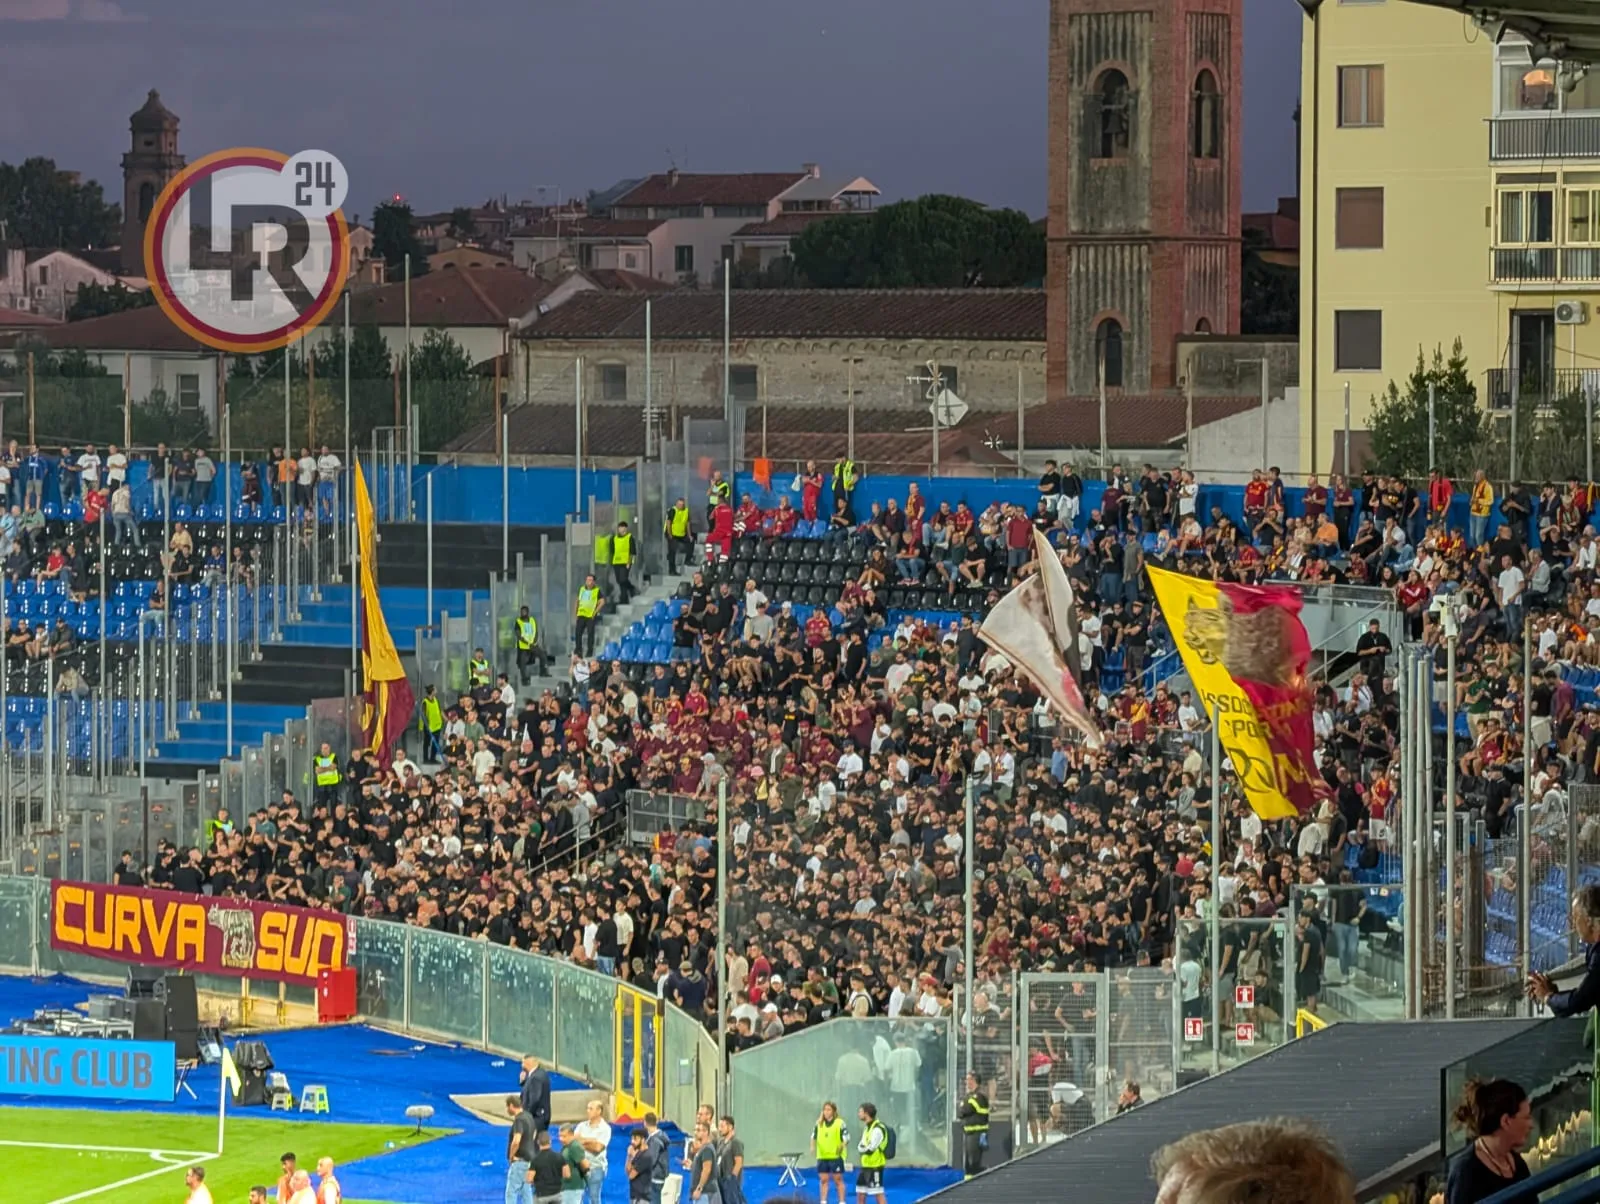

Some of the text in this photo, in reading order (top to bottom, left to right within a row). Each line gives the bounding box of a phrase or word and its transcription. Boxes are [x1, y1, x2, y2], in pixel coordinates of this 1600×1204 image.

[55, 885, 206, 963] CURVA
[257, 911, 344, 978] SUD
[0, 1046, 153, 1090] ING CLUB
